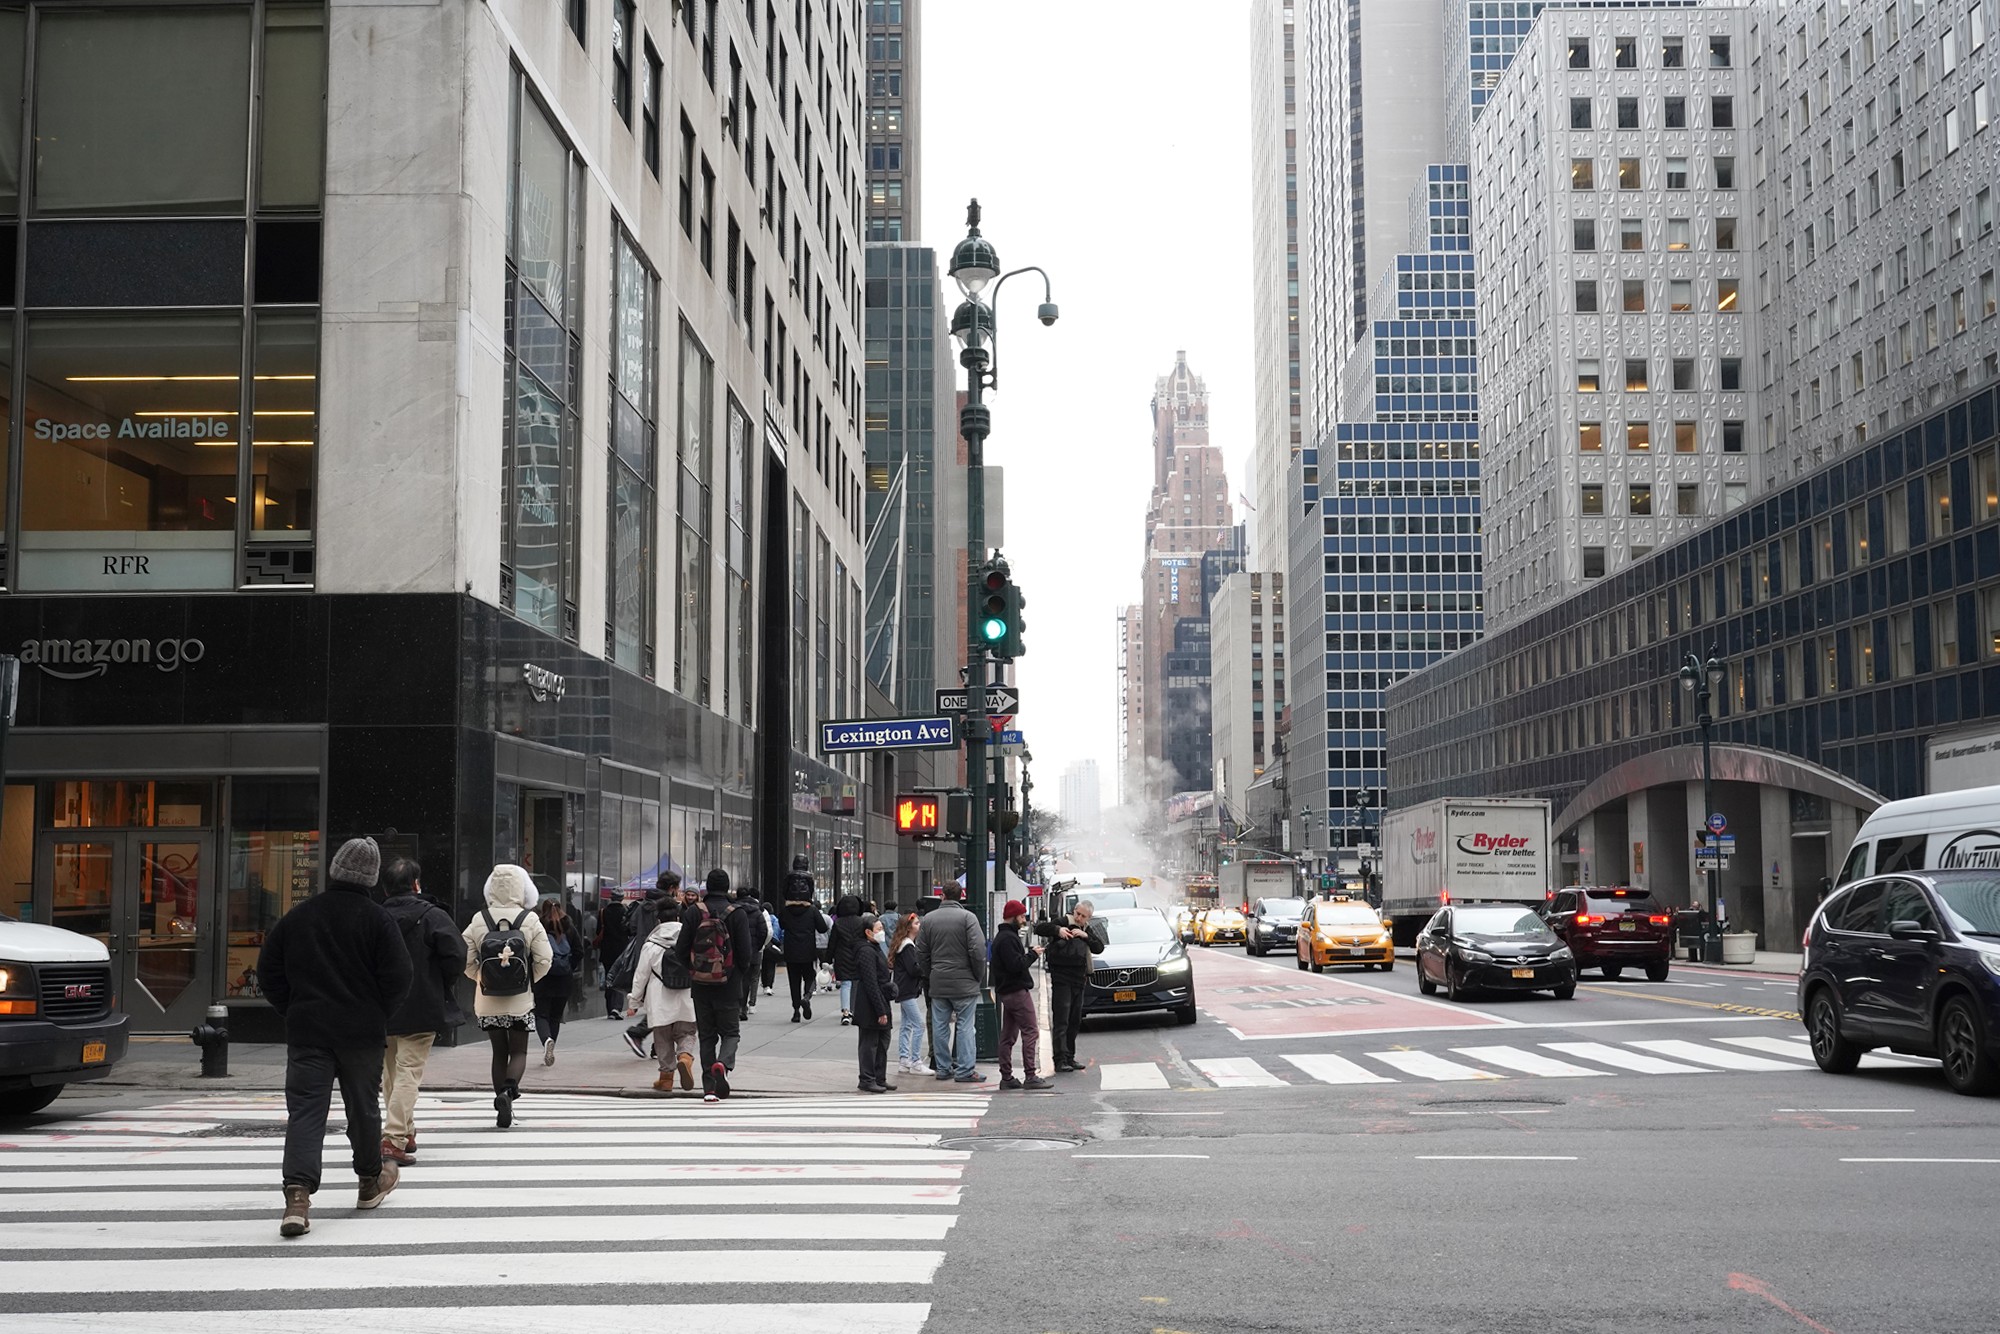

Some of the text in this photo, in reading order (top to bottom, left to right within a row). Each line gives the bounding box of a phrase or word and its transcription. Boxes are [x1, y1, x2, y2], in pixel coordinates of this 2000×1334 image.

[34, 417, 229, 443] Space Available
[102, 555, 150, 574] RFR
[19, 638, 205, 672] amazon go
[943, 697, 967, 708] ONE
[825, 724, 949, 745] Lexington Ave
[1002, 733, 1016, 743] M42
[922, 804, 935, 827] 14
[1450, 809, 1486, 818] Ryder.com
[1473, 833, 1529, 851] Ryder
[1494, 848, 1511, 856] Ever
[65, 985, 91, 998] GMC
